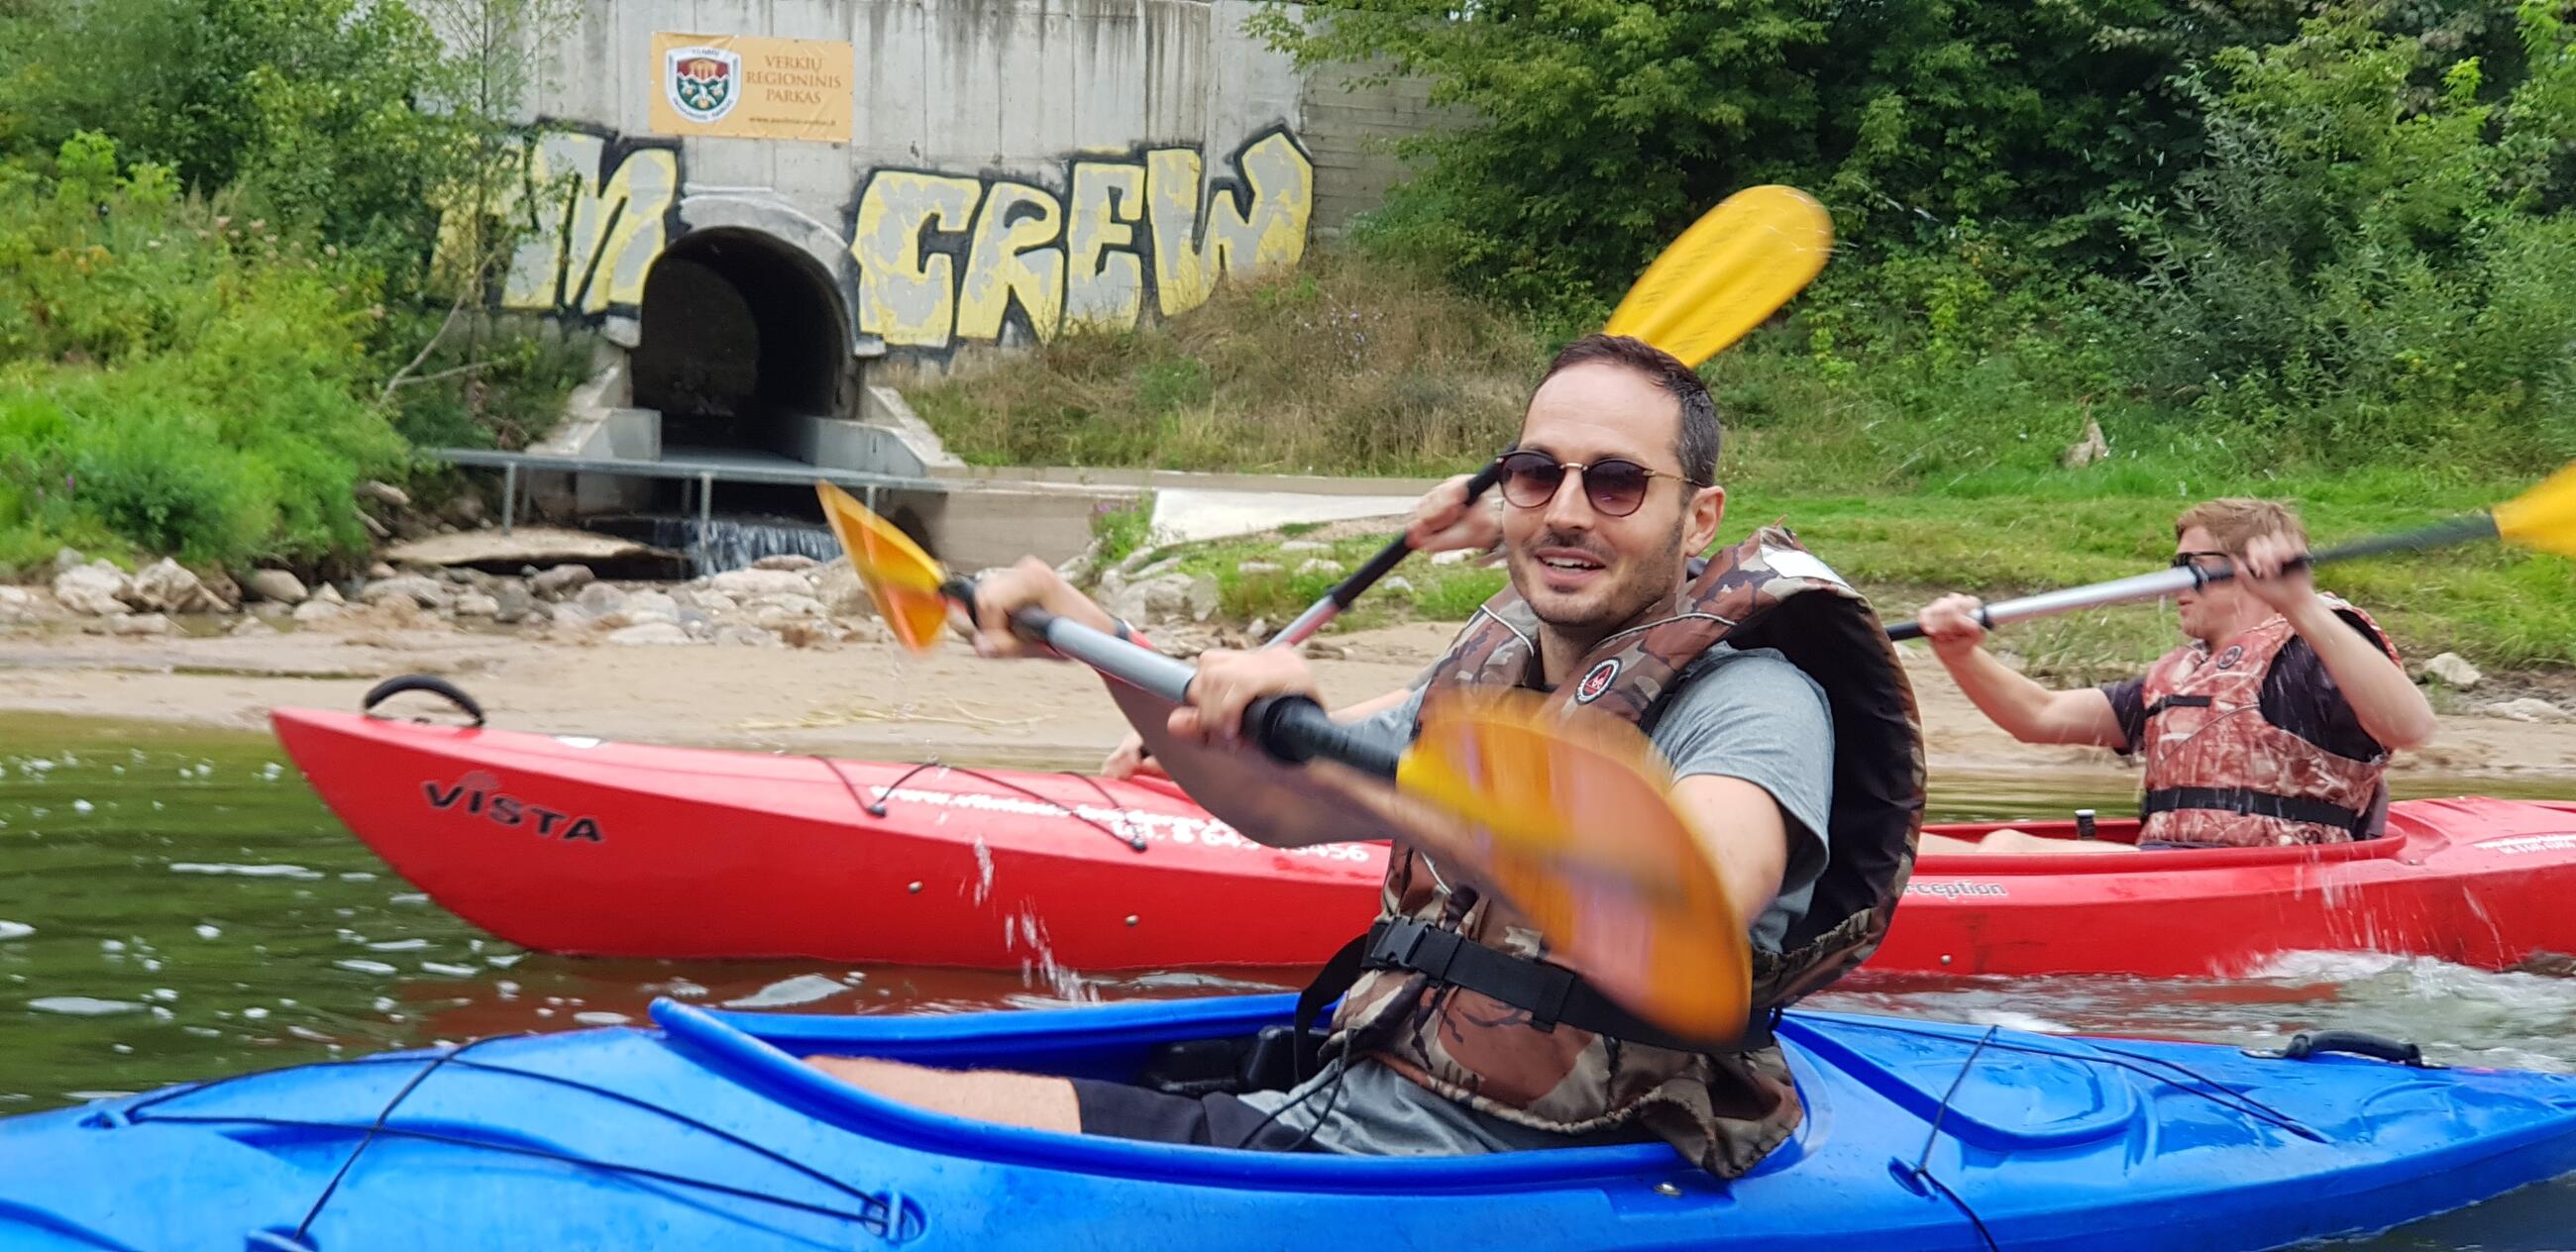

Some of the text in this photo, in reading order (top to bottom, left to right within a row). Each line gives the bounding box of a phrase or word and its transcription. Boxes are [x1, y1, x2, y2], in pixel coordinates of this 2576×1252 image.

[746, 71, 841, 88] REGIONINIS
[766, 89, 821, 104] PARKAS
[844, 125, 1313, 349] CREW
[422, 781, 603, 842] VISTA
